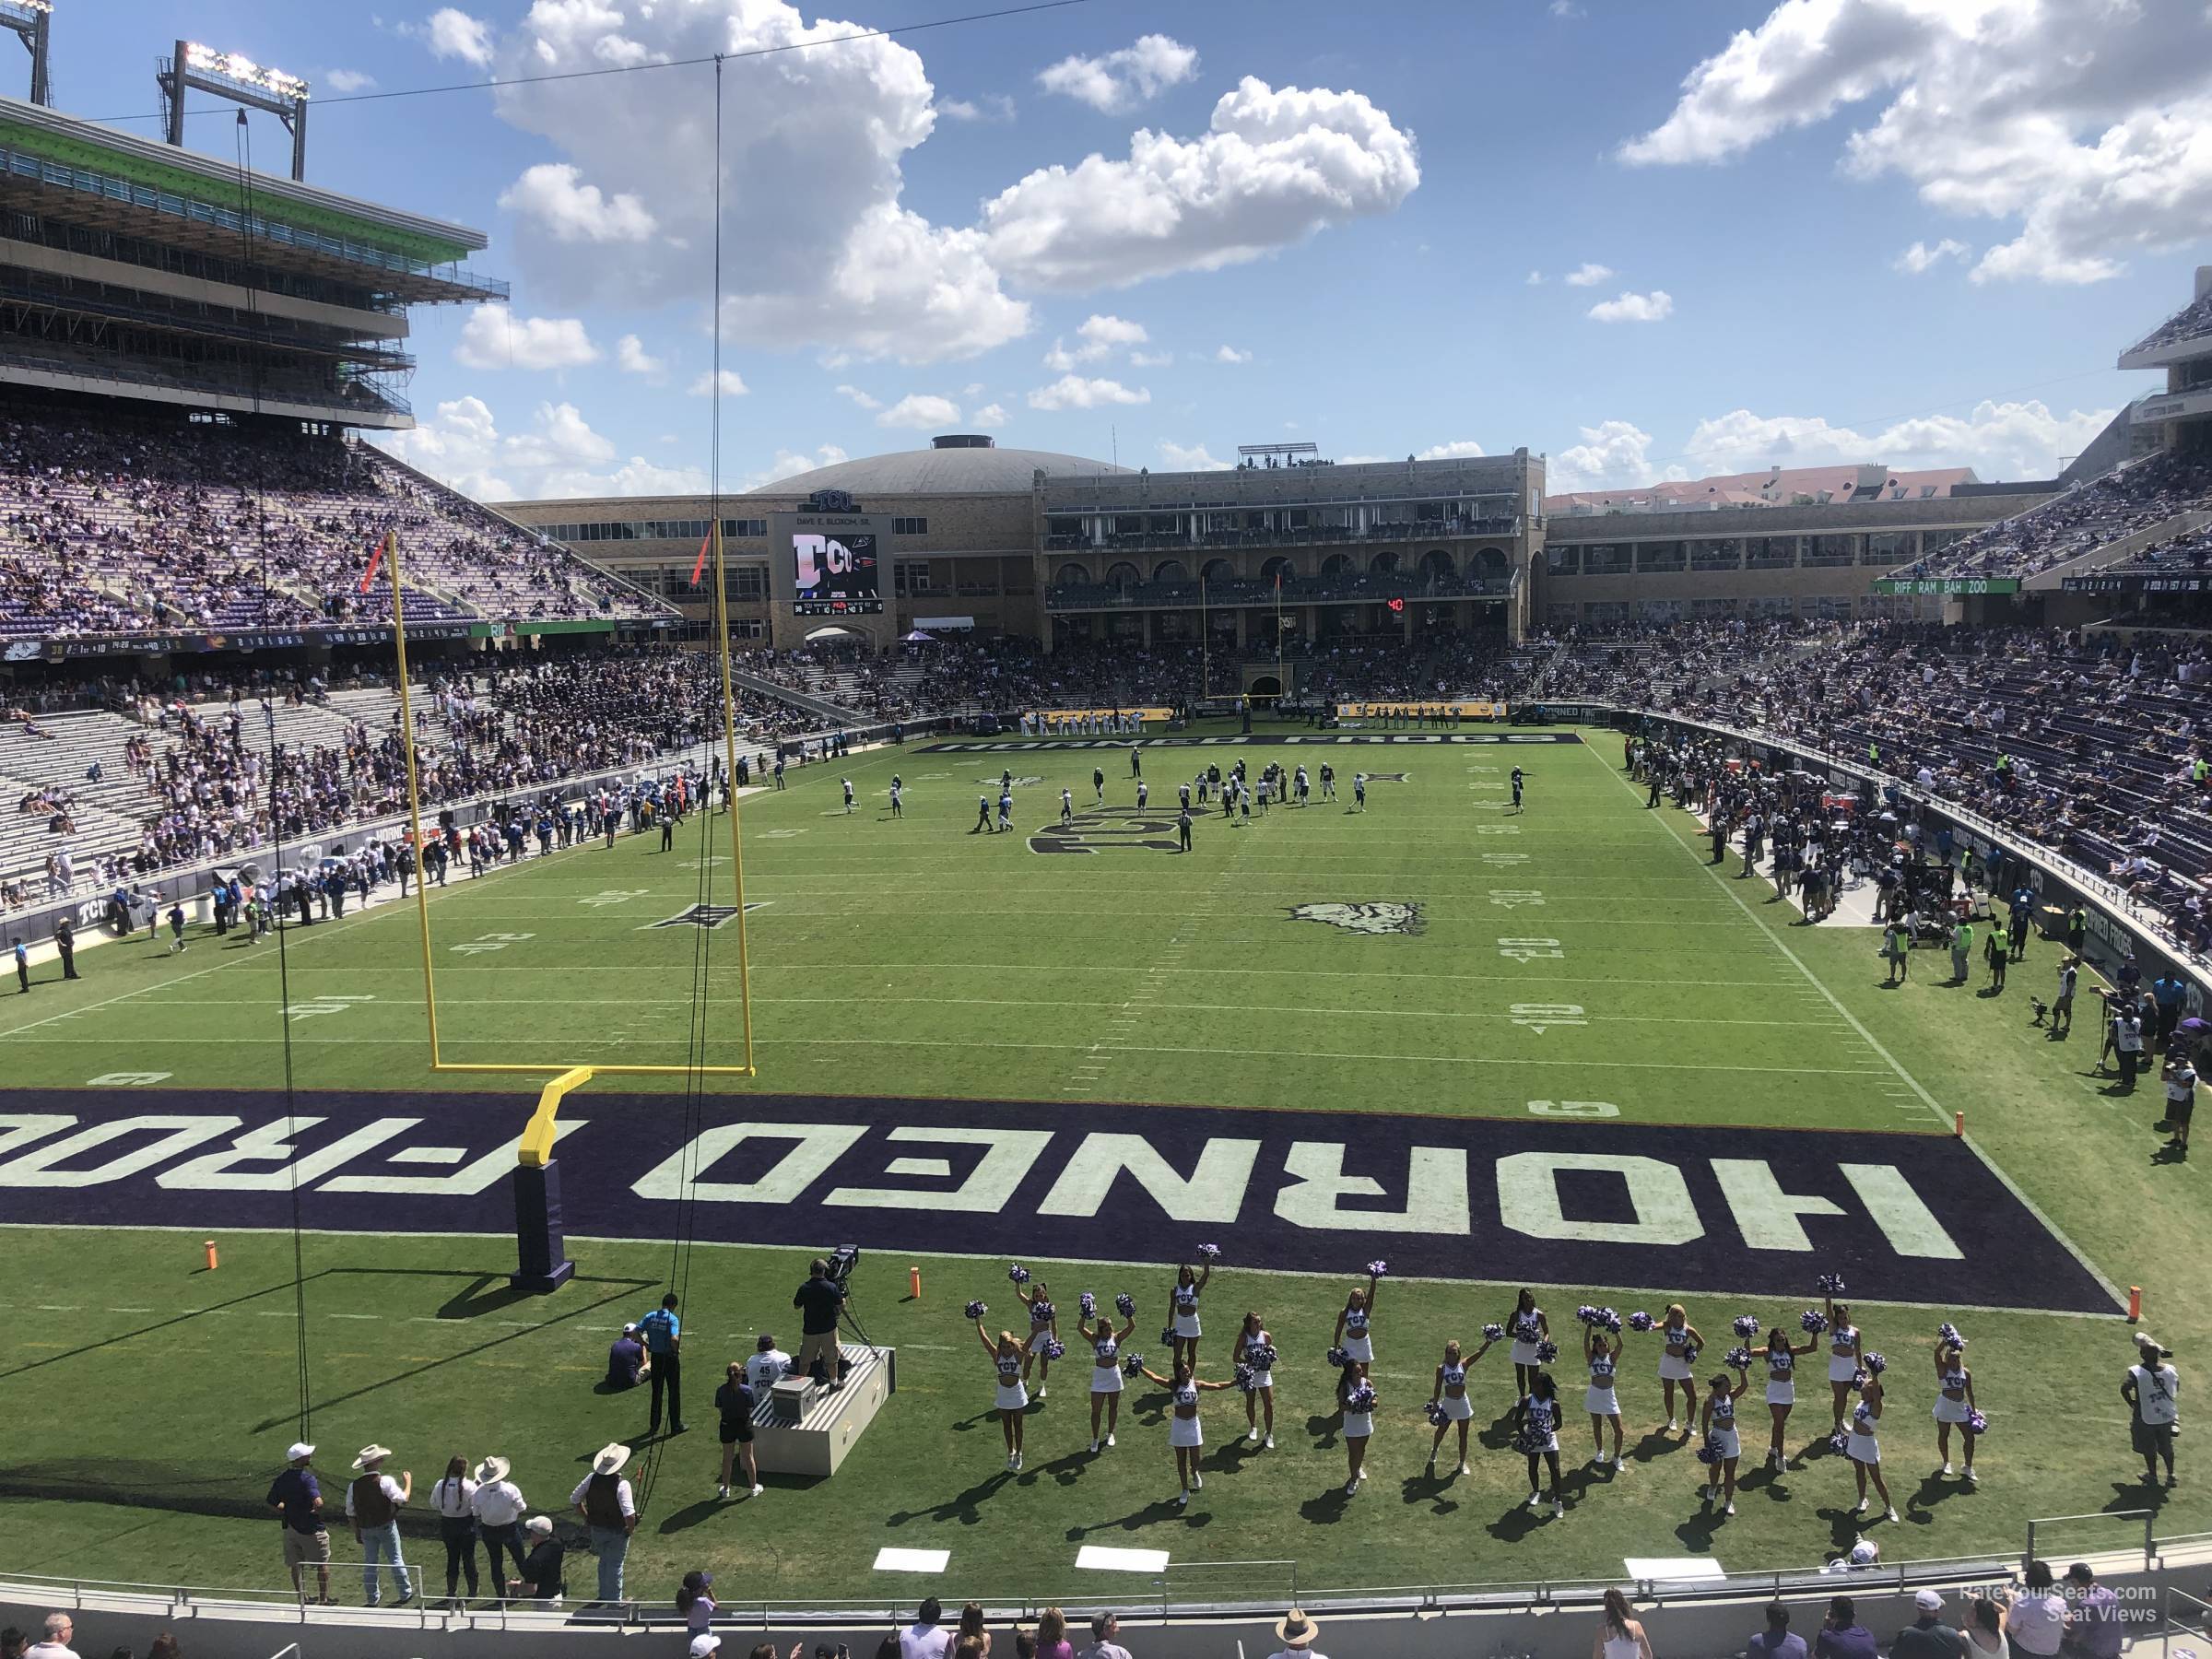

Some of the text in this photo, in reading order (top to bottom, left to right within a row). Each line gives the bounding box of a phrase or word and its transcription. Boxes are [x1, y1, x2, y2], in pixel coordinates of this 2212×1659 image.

[816, 490, 853, 512] TCU
[793, 535, 852, 588] TCU
[1894, 582, 1988, 594] RIFF RAM BAH ZOO
[1388, 599, 1404, 611] 40
[52, 645, 64, 654] 38
[938, 735, 1557, 751] HORNED FROGS
[1830, 769, 1846, 788] HORNED
[376, 824, 406, 842] HORNE
[449, 933, 536, 951] 20
[1498, 937, 1565, 959] 20
[278, 994, 376, 1015] 10
[1510, 1003, 1588, 1025] 10
[630, 1122, 1965, 1259] HORNED
[1347, 1315, 1366, 1327] TCU
[1096, 1346, 1118, 1357] TCU
[759, 1366, 770, 1374] 45
[998, 1362, 1018, 1374] TCU
[1591, 1363, 1614, 1374] TCU
[1444, 1371, 1465, 1383] TCU
[1176, 1392, 1197, 1403] TCU
[1529, 1408, 1552, 1418] TCU
